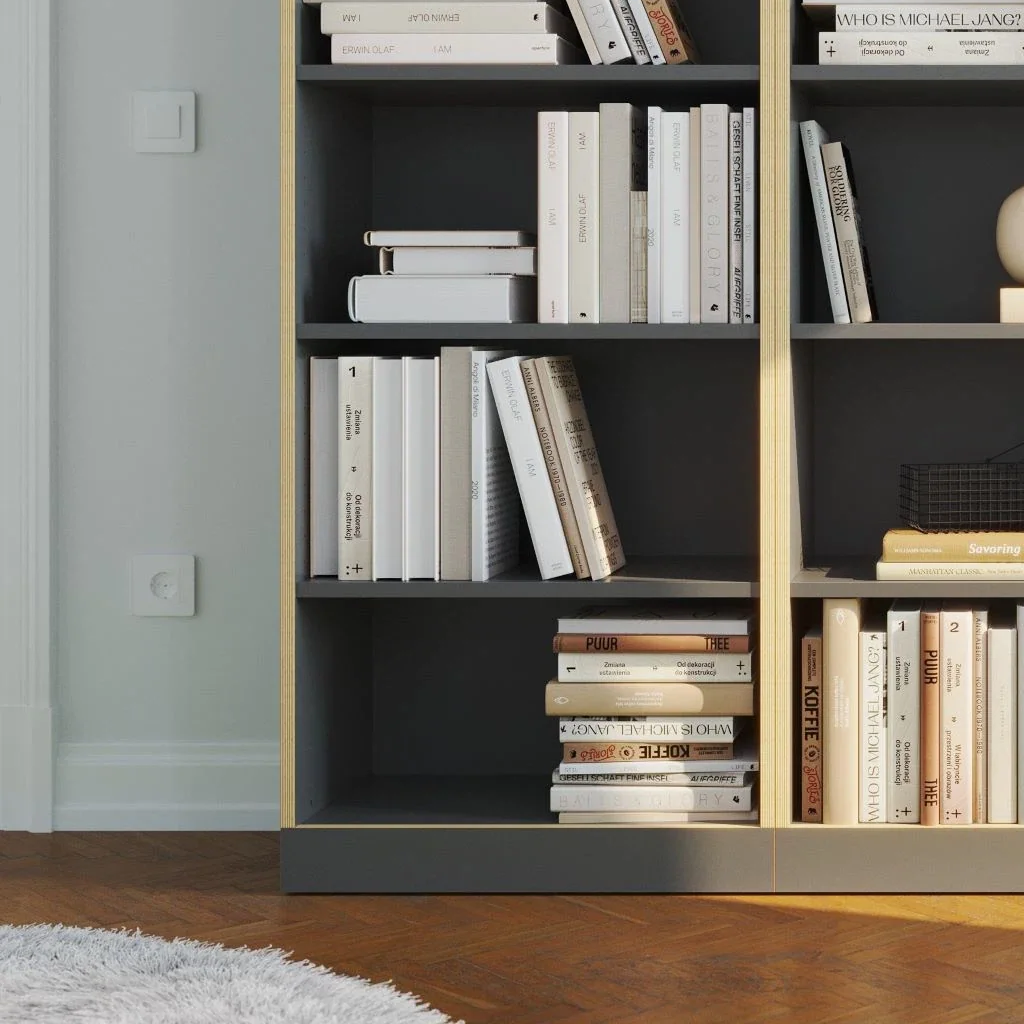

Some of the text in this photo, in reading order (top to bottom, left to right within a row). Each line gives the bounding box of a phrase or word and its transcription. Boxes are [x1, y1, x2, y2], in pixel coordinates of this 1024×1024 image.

[407, 13, 460, 23] ERWIN OLAF
[837, 13, 1021, 26] WHO IS MICHAEL JANG?
[648, 5, 679, 48] STORIES
[342, 45, 395, 55] ERWIN OLAF
[858, 39, 907, 47] do konstrukcji
[958, 39, 996, 47] ustawienia
[861, 48, 905, 57] Od dekoracji
[547, 122, 556, 149] ERWIN
[672, 122, 681, 149] ERWIN
[827, 166, 842, 217] FOR GLORY
[834, 165, 850, 221] SOLDIERING
[579, 193, 587, 243] ERWIN OLAF
[706, 214, 719, 294] GLORY
[349, 366, 356, 377] 1
[523, 366, 534, 385] ANNI
[528, 386, 541, 412] ALBERS
[539, 426, 556, 467] NOTEBOOK
[345, 492, 351, 501] do
[353, 494, 361, 538] Od dekoracji
[968, 543, 1021, 556] Savoring
[898, 621, 905, 632] 1
[950, 622, 959, 633] 2
[586, 636, 730, 651] PUUR THEE
[687, 661, 715, 669] dekoracji
[571, 723, 732, 735] WHO IS MICHAEL JANG?
[868, 646, 880, 822] WHO IS MICHAEL JANG?
[924, 650, 938, 807] PUUR THEE
[803, 686, 819, 804] KOFFIE STORIES
[895, 739, 901, 748] do
[580, 745, 690, 761] KOFFIE STORIES
[902, 741, 910, 784] Od dekoracji
